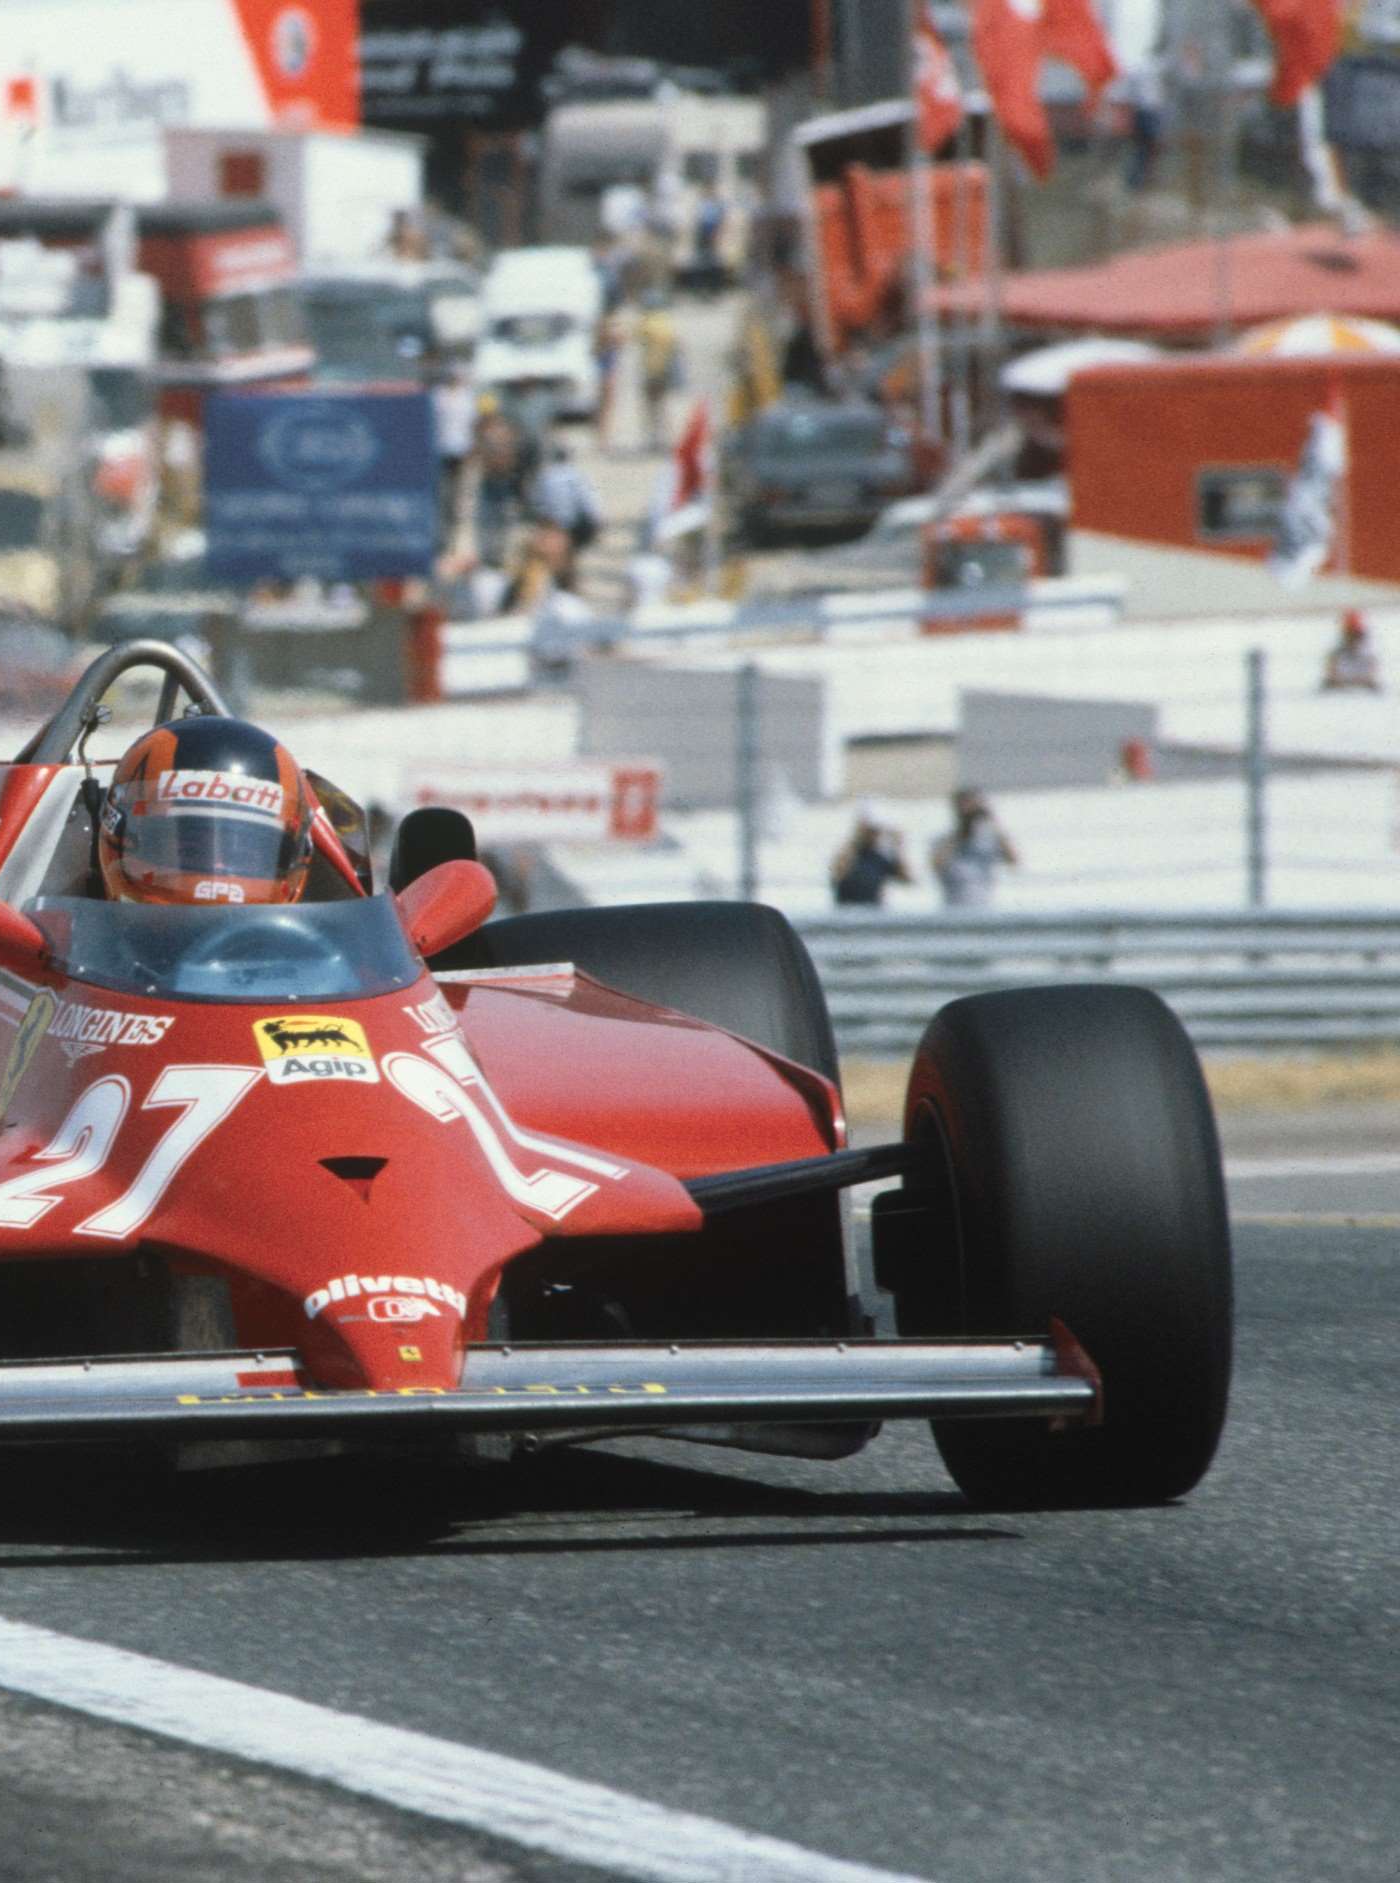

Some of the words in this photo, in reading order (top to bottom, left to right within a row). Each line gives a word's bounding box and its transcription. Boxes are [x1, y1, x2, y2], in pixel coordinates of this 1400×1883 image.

[160, 772, 282, 808] Labatt
[47, 1001, 177, 1046] LONGINES
[281, 1056, 367, 1077] Agip
[381, 1028, 631, 1221] 27
